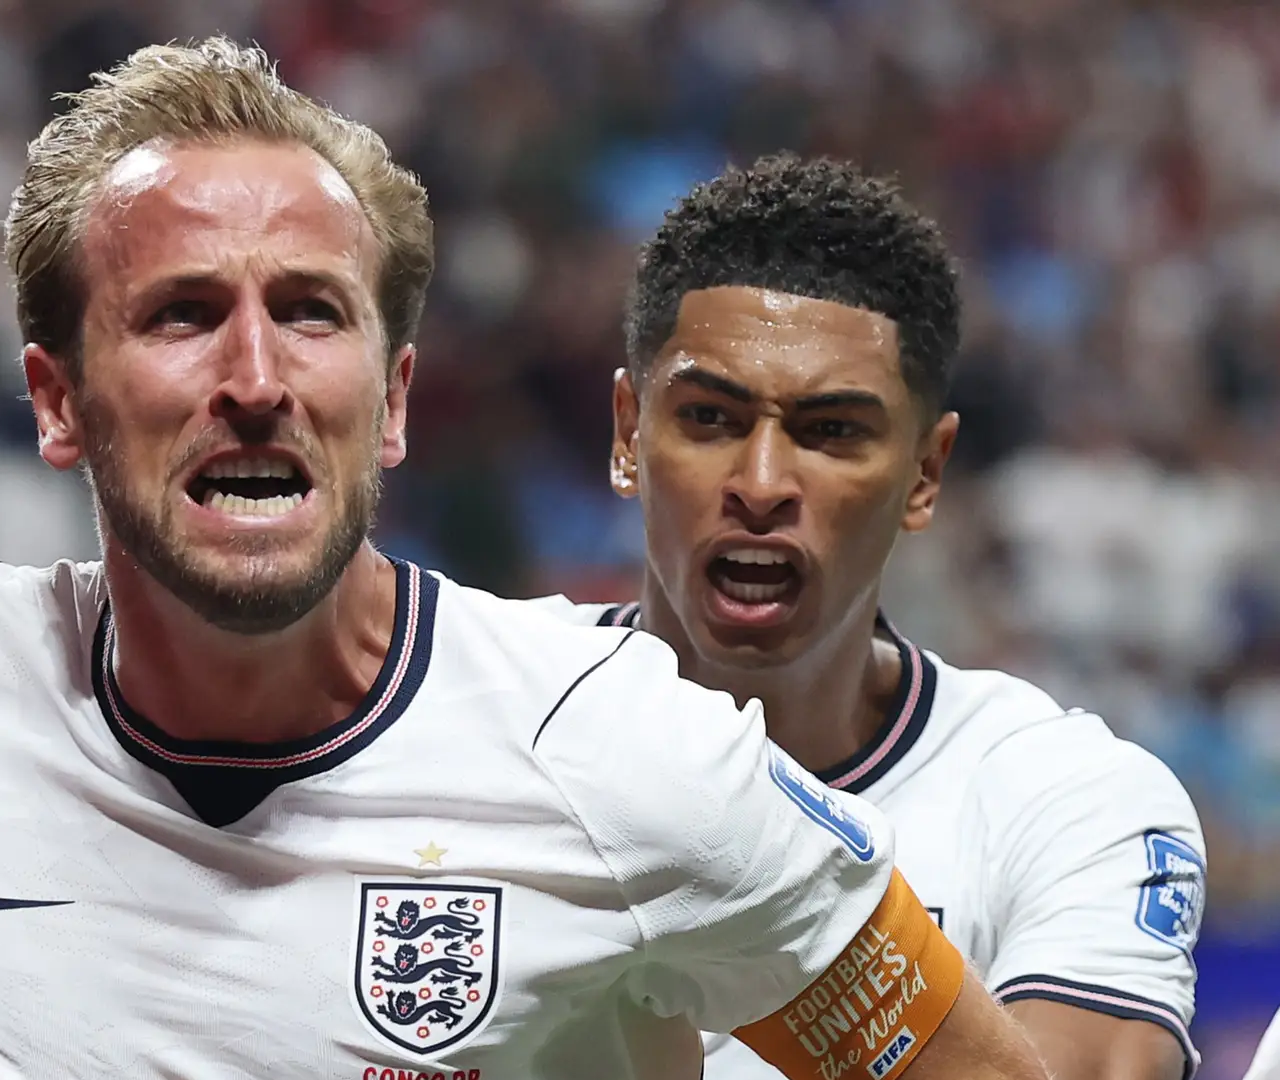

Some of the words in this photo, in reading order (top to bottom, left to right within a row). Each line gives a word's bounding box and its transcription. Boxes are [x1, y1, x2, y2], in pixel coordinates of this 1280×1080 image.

[783, 924, 889, 1034] FOOTBALL
[799, 941, 907, 1057] UNITES
[858, 961, 928, 1050] World
[873, 1035, 912, 1076] FIFA
